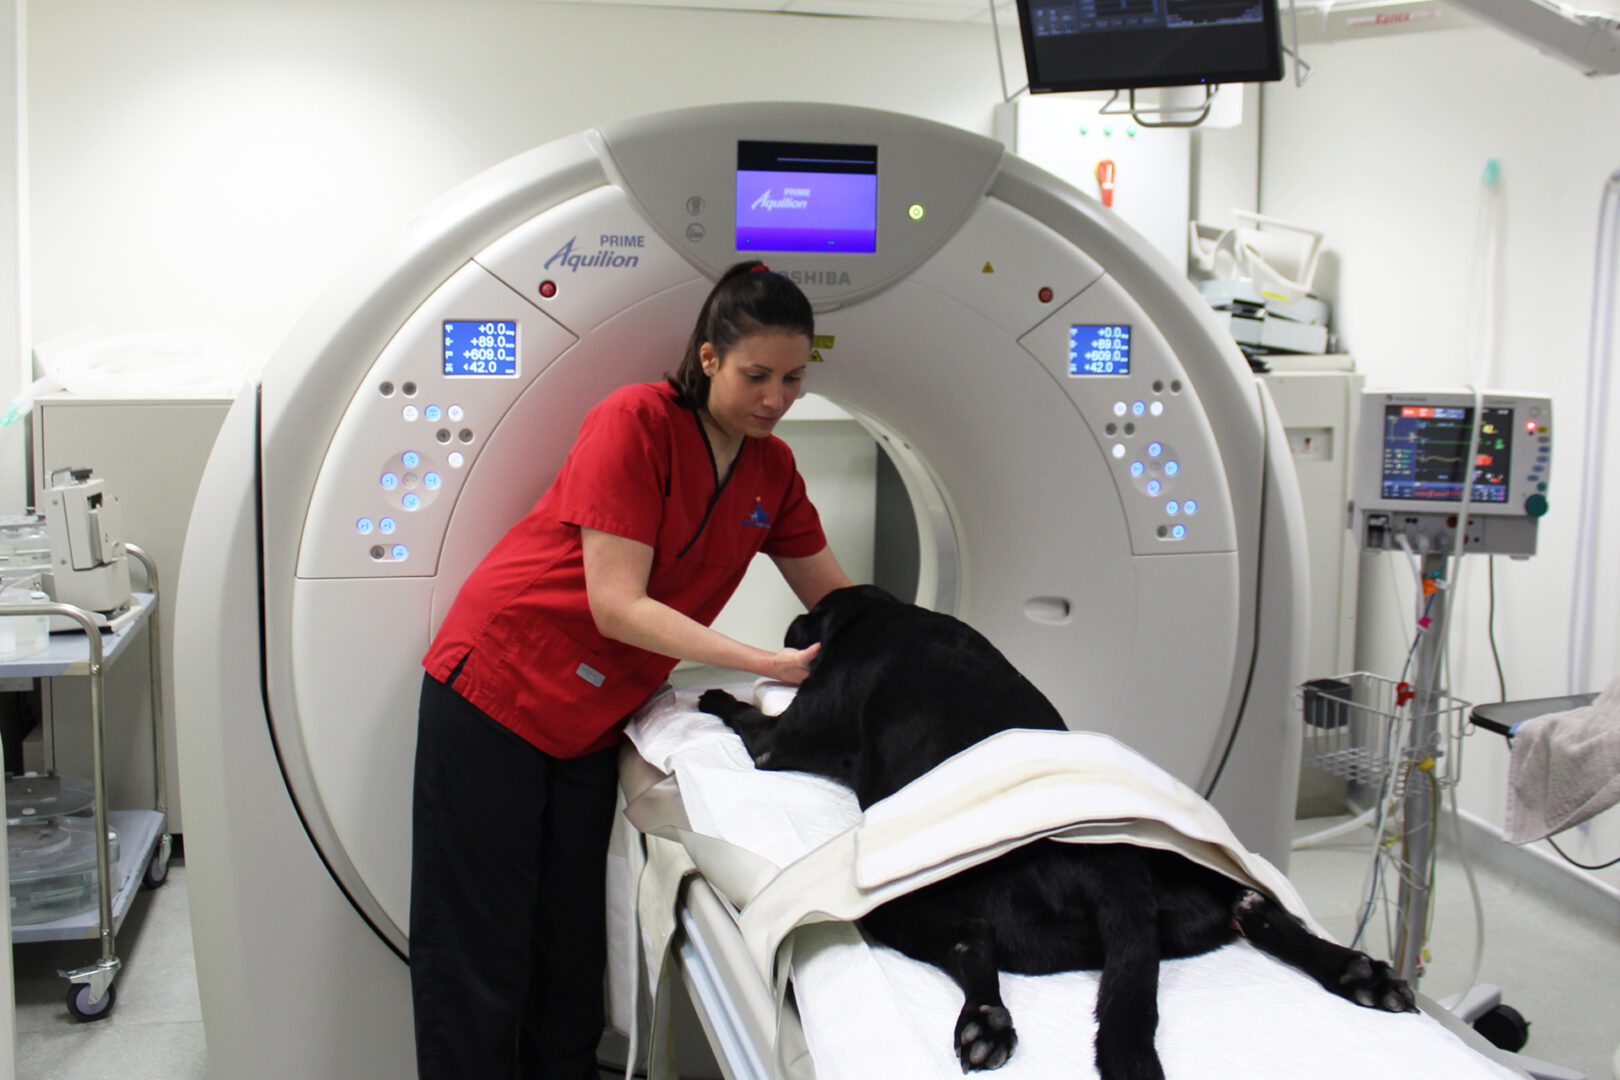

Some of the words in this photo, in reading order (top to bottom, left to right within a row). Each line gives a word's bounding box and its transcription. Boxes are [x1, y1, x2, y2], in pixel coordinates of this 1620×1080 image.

[751, 188, 808, 211] Aquilion
[600, 235, 645, 247] PRIME
[543, 236, 639, 272] Aquilion
